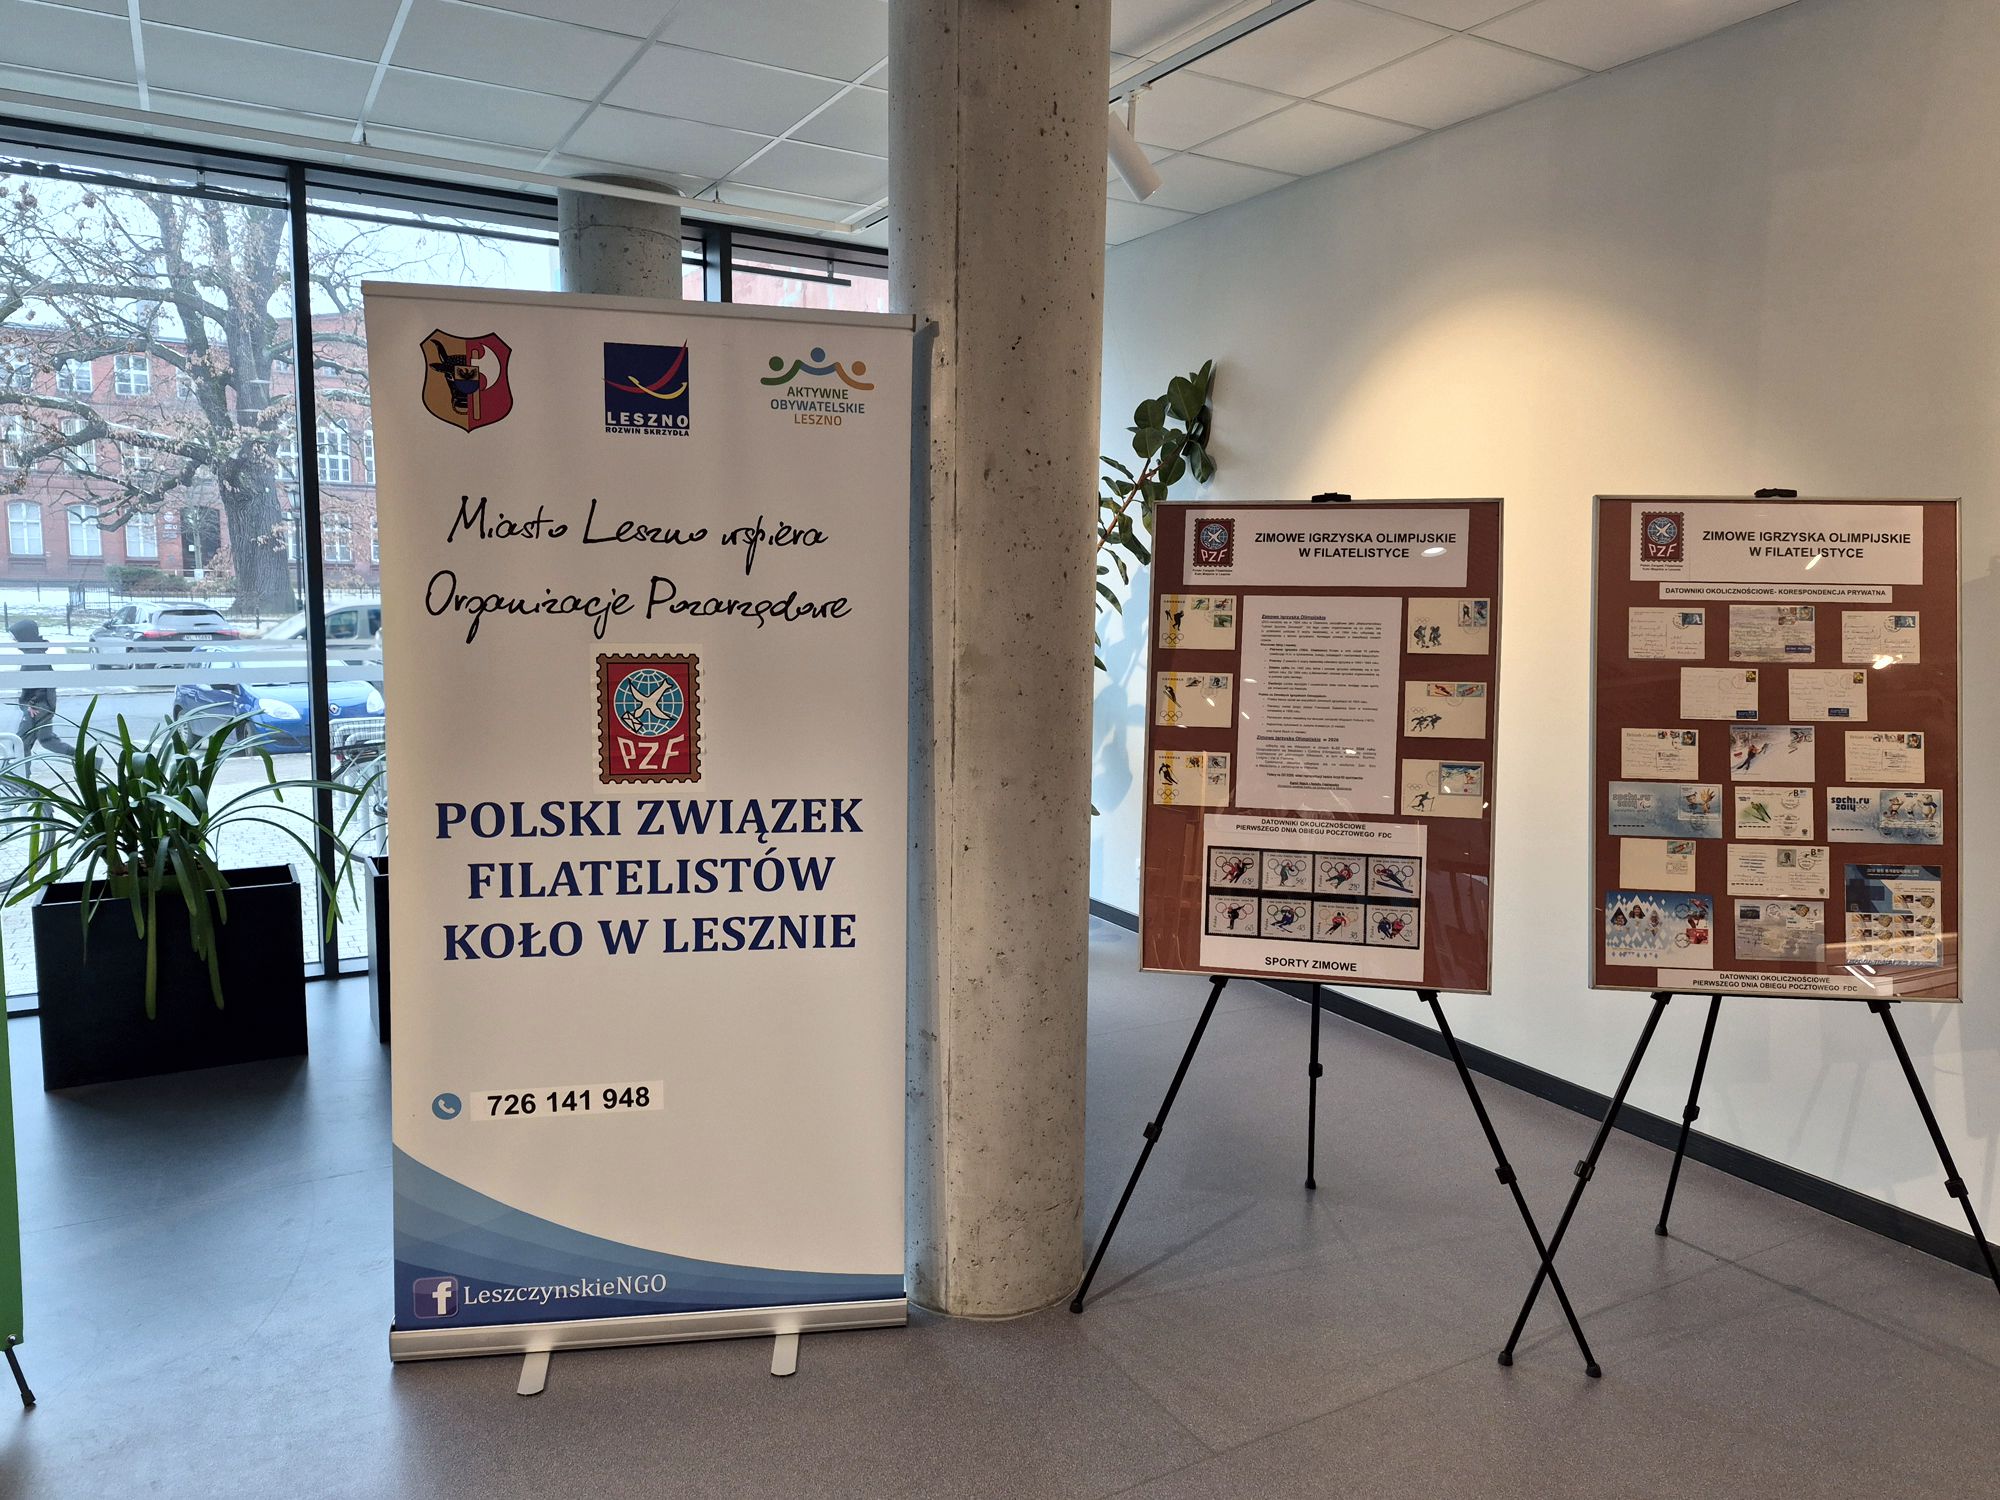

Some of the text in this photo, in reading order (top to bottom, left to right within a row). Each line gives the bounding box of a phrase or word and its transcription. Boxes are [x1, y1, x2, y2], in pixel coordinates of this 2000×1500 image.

[787, 386, 849, 400] AKTYWNE
[770, 398, 865, 414] OBYWATELSKIE
[606, 411, 689, 428] LESZNO
[794, 413, 842, 426] LESZNO
[643, 428, 689, 436] SKRZYDŁA
[447, 496, 828, 575] Miasto Leszno wspiera
[1255, 533, 1456, 543] ZIMOWE IGRZYSKA OLIMPIJSKIE
[1703, 531, 1910, 543] ZIMOWE IGRZYSKA OLIMPIJSKIE
[1200, 548, 1228, 563] PZF
[1299, 548, 1409, 557] W FILATELISTYCE
[1649, 543, 1675, 558] PZF
[1750, 547, 1864, 558] W FILATELISTYCE
[426, 570, 634, 644] Organizacje
[616, 733, 687, 771] PZF
[1831, 796, 1870, 804] sochi.ru
[435, 799, 863, 844] POLSKI ZWIĄZEK
[1261, 818, 1299, 827] DATOWNIKI
[1235, 824, 1280, 833] PIERWSZEGO
[1298, 827, 1325, 835] OBIEGU
[1326, 829, 1375, 838] POCZTOWEGO
[468, 847, 835, 899] FILATELISTÓW
[443, 915, 855, 960] KOŁO W LESZNIE
[1266, 957, 1356, 971] SPORTY ZIMOWE
[1692, 979, 1740, 988] PIERWSZEGO
[1741, 981, 1758, 989] DNIA
[1760, 982, 1788, 990] OBIEGU
[1788, 983, 1840, 992] POCZTOWEGO
[1719, 973, 1831, 985] DATOWNIKI OKOLICZNOŚCIOWE
[488, 1087, 649, 1116] 726 141 948
[464, 1273, 667, 1305] LeszczynskieNGO
